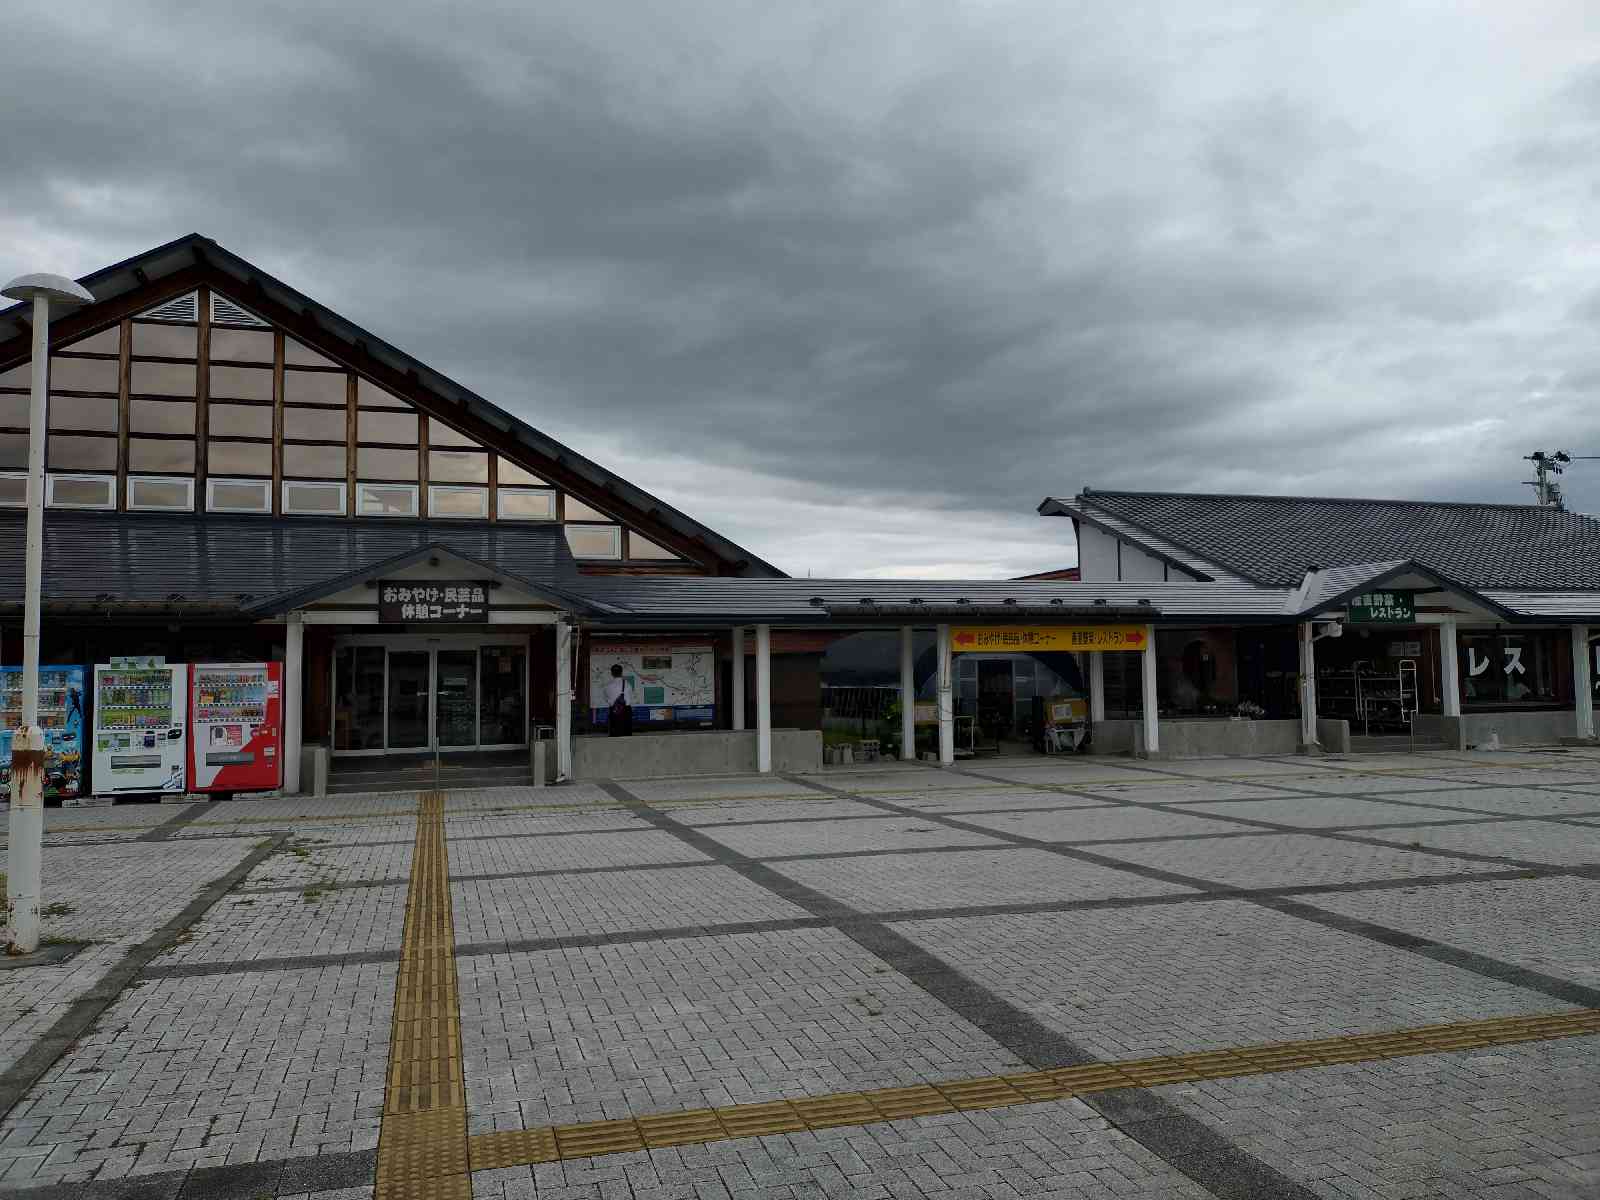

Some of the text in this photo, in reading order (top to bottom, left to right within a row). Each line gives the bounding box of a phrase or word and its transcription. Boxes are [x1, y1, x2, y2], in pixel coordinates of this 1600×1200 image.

[401, 604, 482, 619] 休憩コーナー
[1370, 607, 1411, 619] レストラン
